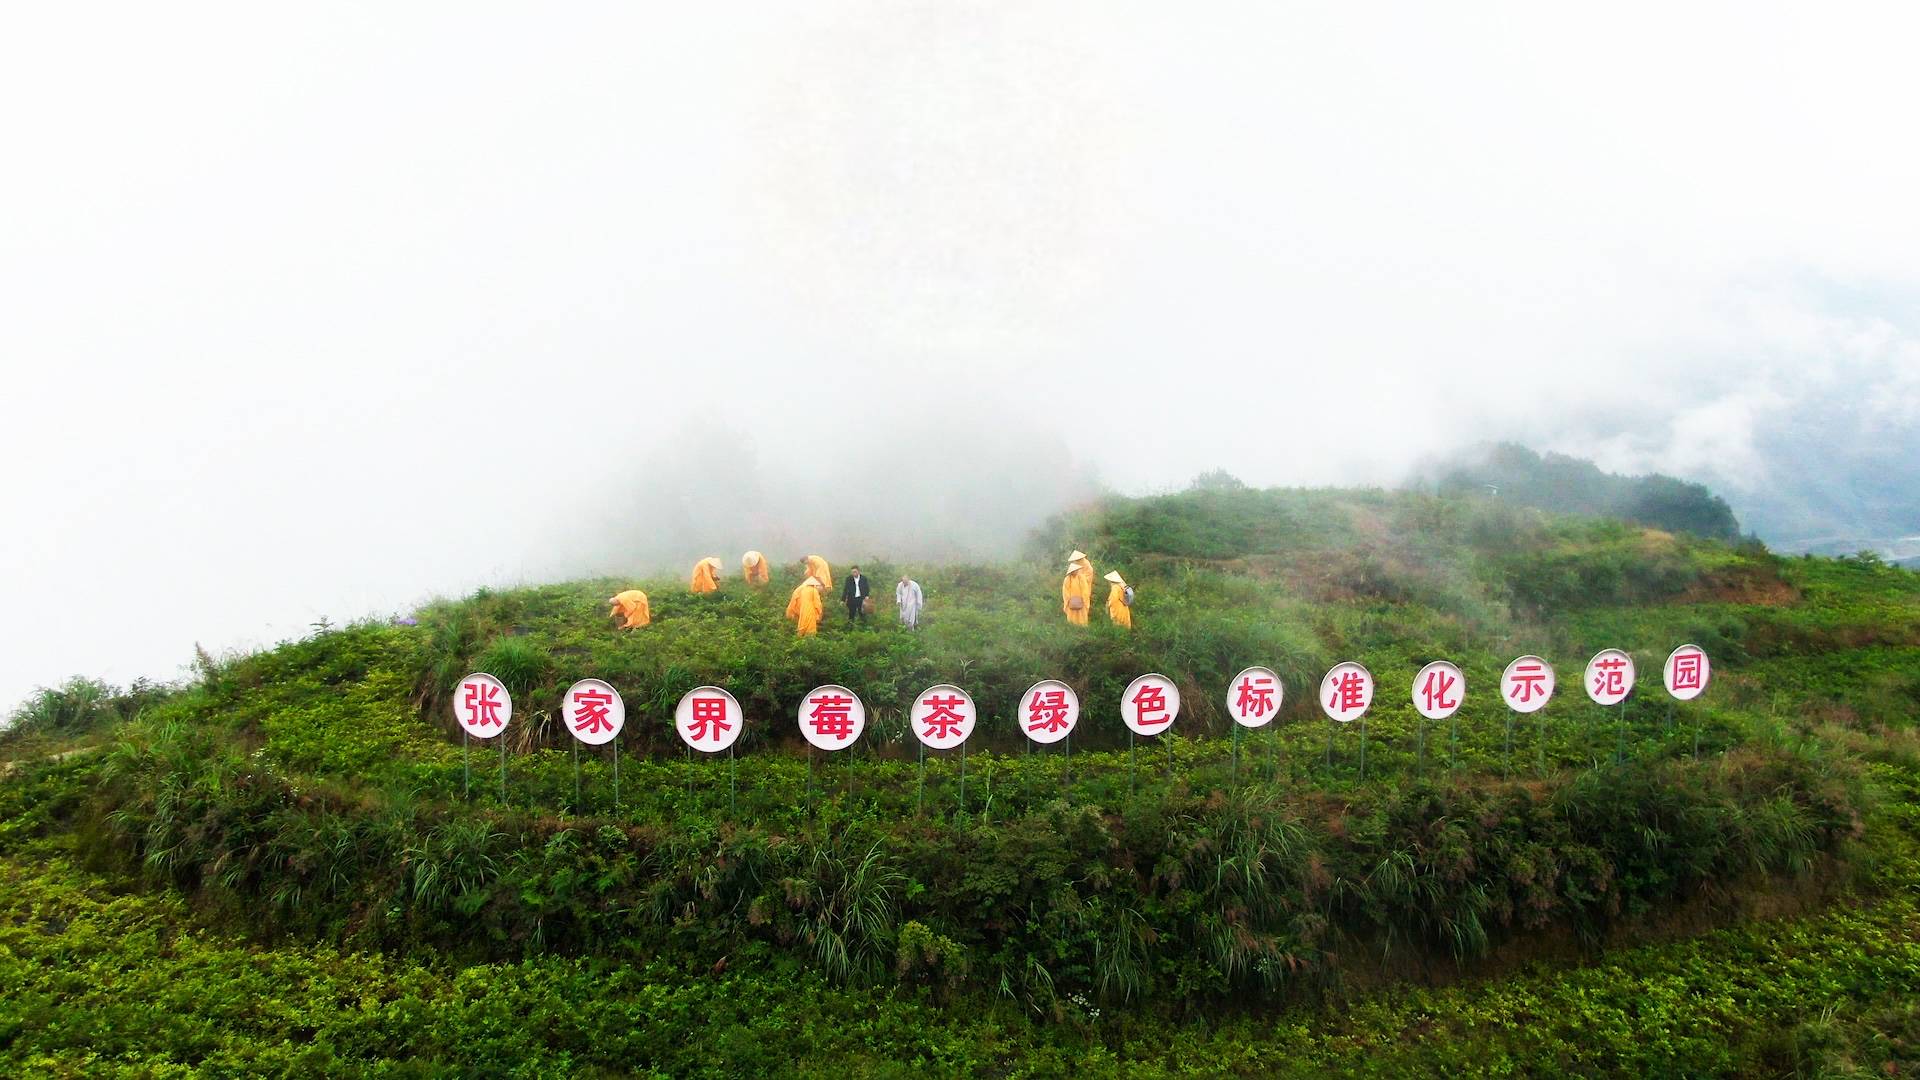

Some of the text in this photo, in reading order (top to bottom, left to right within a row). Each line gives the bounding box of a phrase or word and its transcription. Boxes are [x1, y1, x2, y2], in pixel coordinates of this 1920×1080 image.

[463, 653, 1711, 742] 张家界莓茶绿色标准化示范园
